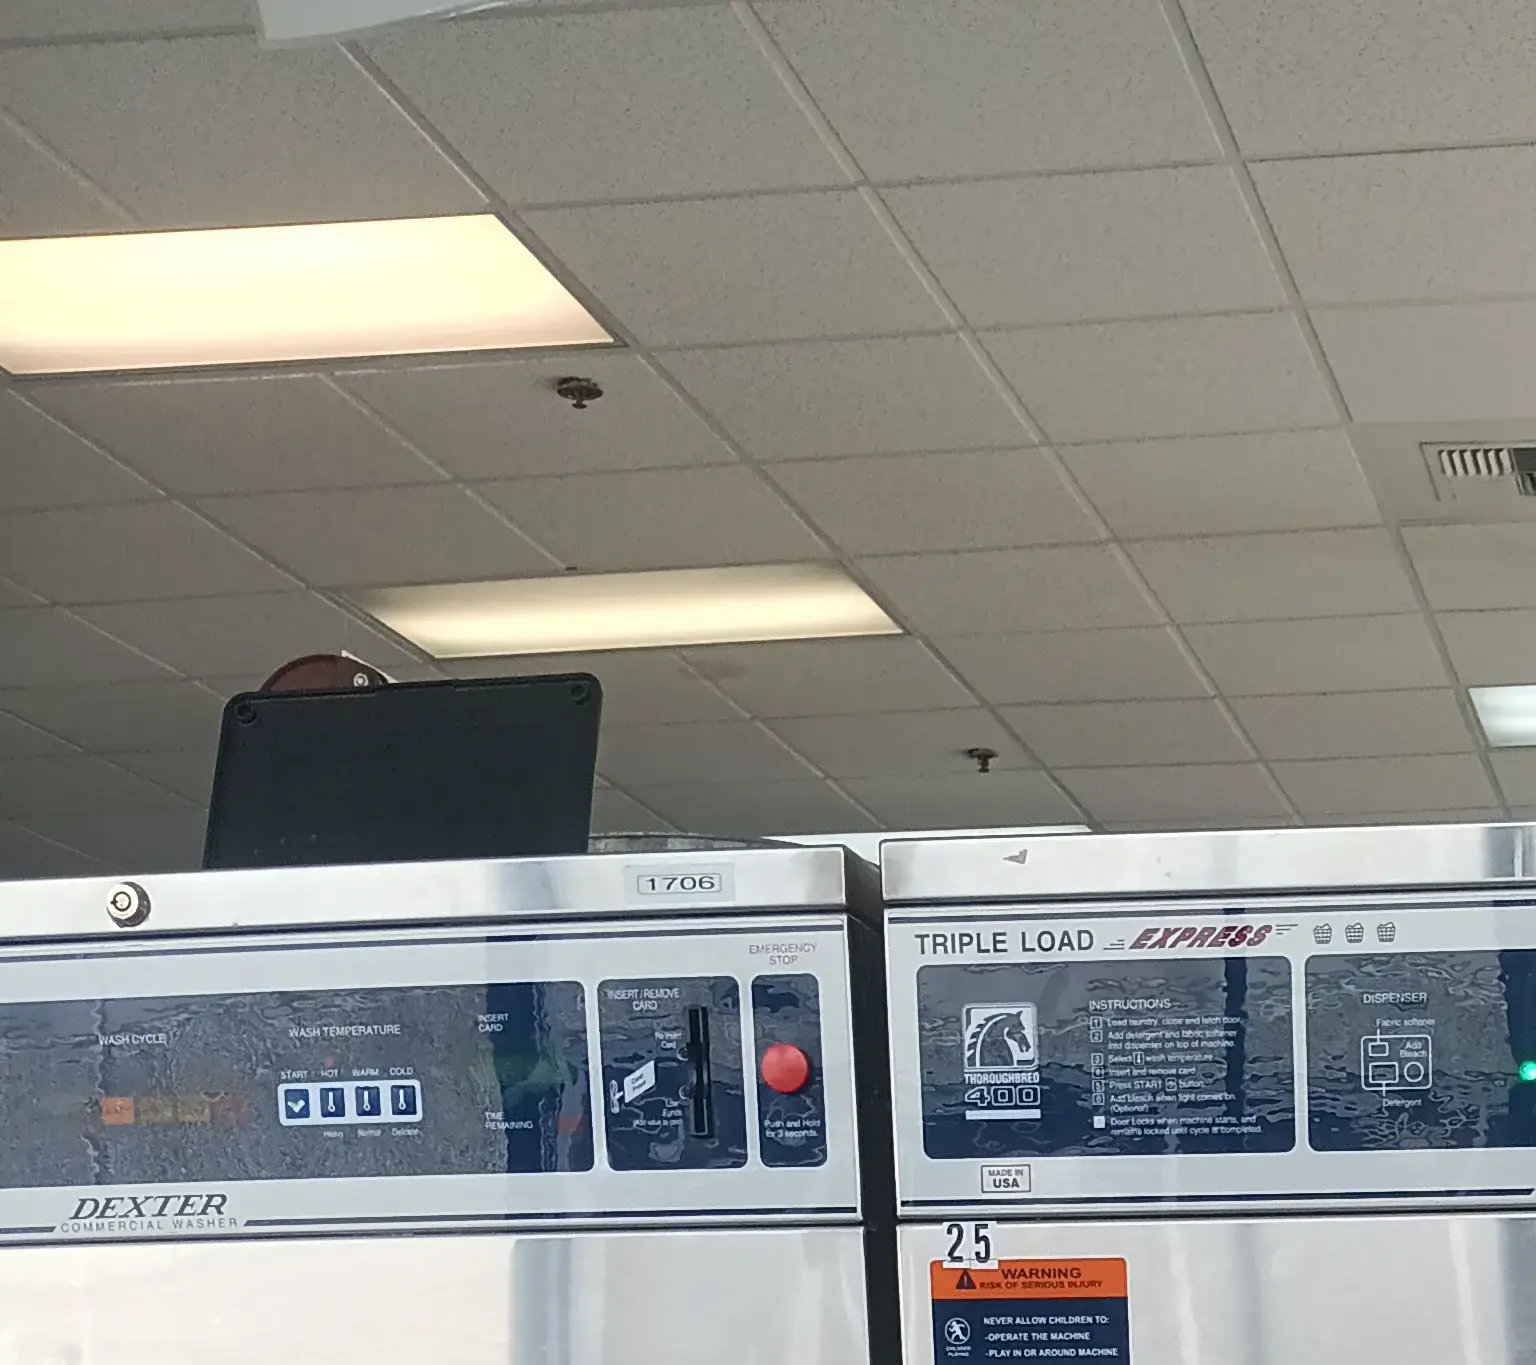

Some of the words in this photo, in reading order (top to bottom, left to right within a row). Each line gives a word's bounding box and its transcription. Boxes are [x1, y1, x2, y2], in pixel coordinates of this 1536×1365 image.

[646, 875, 715, 891] 1706
[915, 931, 1008, 955] TRIPLE
[1021, 930, 1095, 952] LOAD
[1129, 924, 1273, 950] EXPRESS
[748, 942, 817, 954] EMERGENCY
[769, 955, 798, 965] STOP
[1362, 991, 1428, 1004] DISPENSER
[632, 1000, 658, 1011] CARD
[1089, 999, 1172, 1010] INSTRUCTIONS
[477, 1013, 509, 1023] INSERT
[288, 1027, 321, 1038] WASH
[321, 1024, 401, 1037] TEMPERATURE
[478, 1023, 503, 1033] CARD
[98, 1034, 130, 1046] WASH
[131, 1033, 167, 1045] CYCLE
[320, 1069, 339, 1078] HOT
[389, 1067, 414, 1076] COLD
[963, 1072, 1040, 1084] THOROUGHBRED
[1133, 1080, 1163, 1089] START
[964, 1084, 1041, 1107] 400
[484, 1111, 505, 1120] TIME
[485, 1120, 534, 1130] REMAINING
[988, 1169, 1013, 1177] MADE
[1014, 1168, 1024, 1177] IN
[992, 1177, 1020, 1189] USA
[68, 1193, 228, 1220] DEXTER
[60, 1220, 163, 1233] COMMERCIAL
[172, 1217, 237, 1229] WASHER
[1001, 1267, 1082, 1280] WARNING
[979, 1281, 1002, 1290] RISK
[1005, 1280, 1018, 1290] OF
[1021, 1280, 1065, 1289] SERIOUS
[1067, 1279, 1103, 1289] INJURY
[983, 1316, 1014, 1326] NEVER
[1014, 1316, 1047, 1325] ALLOW
[1048, 1315, 1093, 1325] CHILDREN
[1030, 1332, 1048, 1341] THE
[1050, 1332, 1091, 1341] MACHINE
[1012, 1349, 1022, 1358] IN
[1023, 1349, 1037, 1357] OR
[1038, 1348, 1077, 1357] AROUND
[1078, 1348, 1119, 1357] MACHINE
